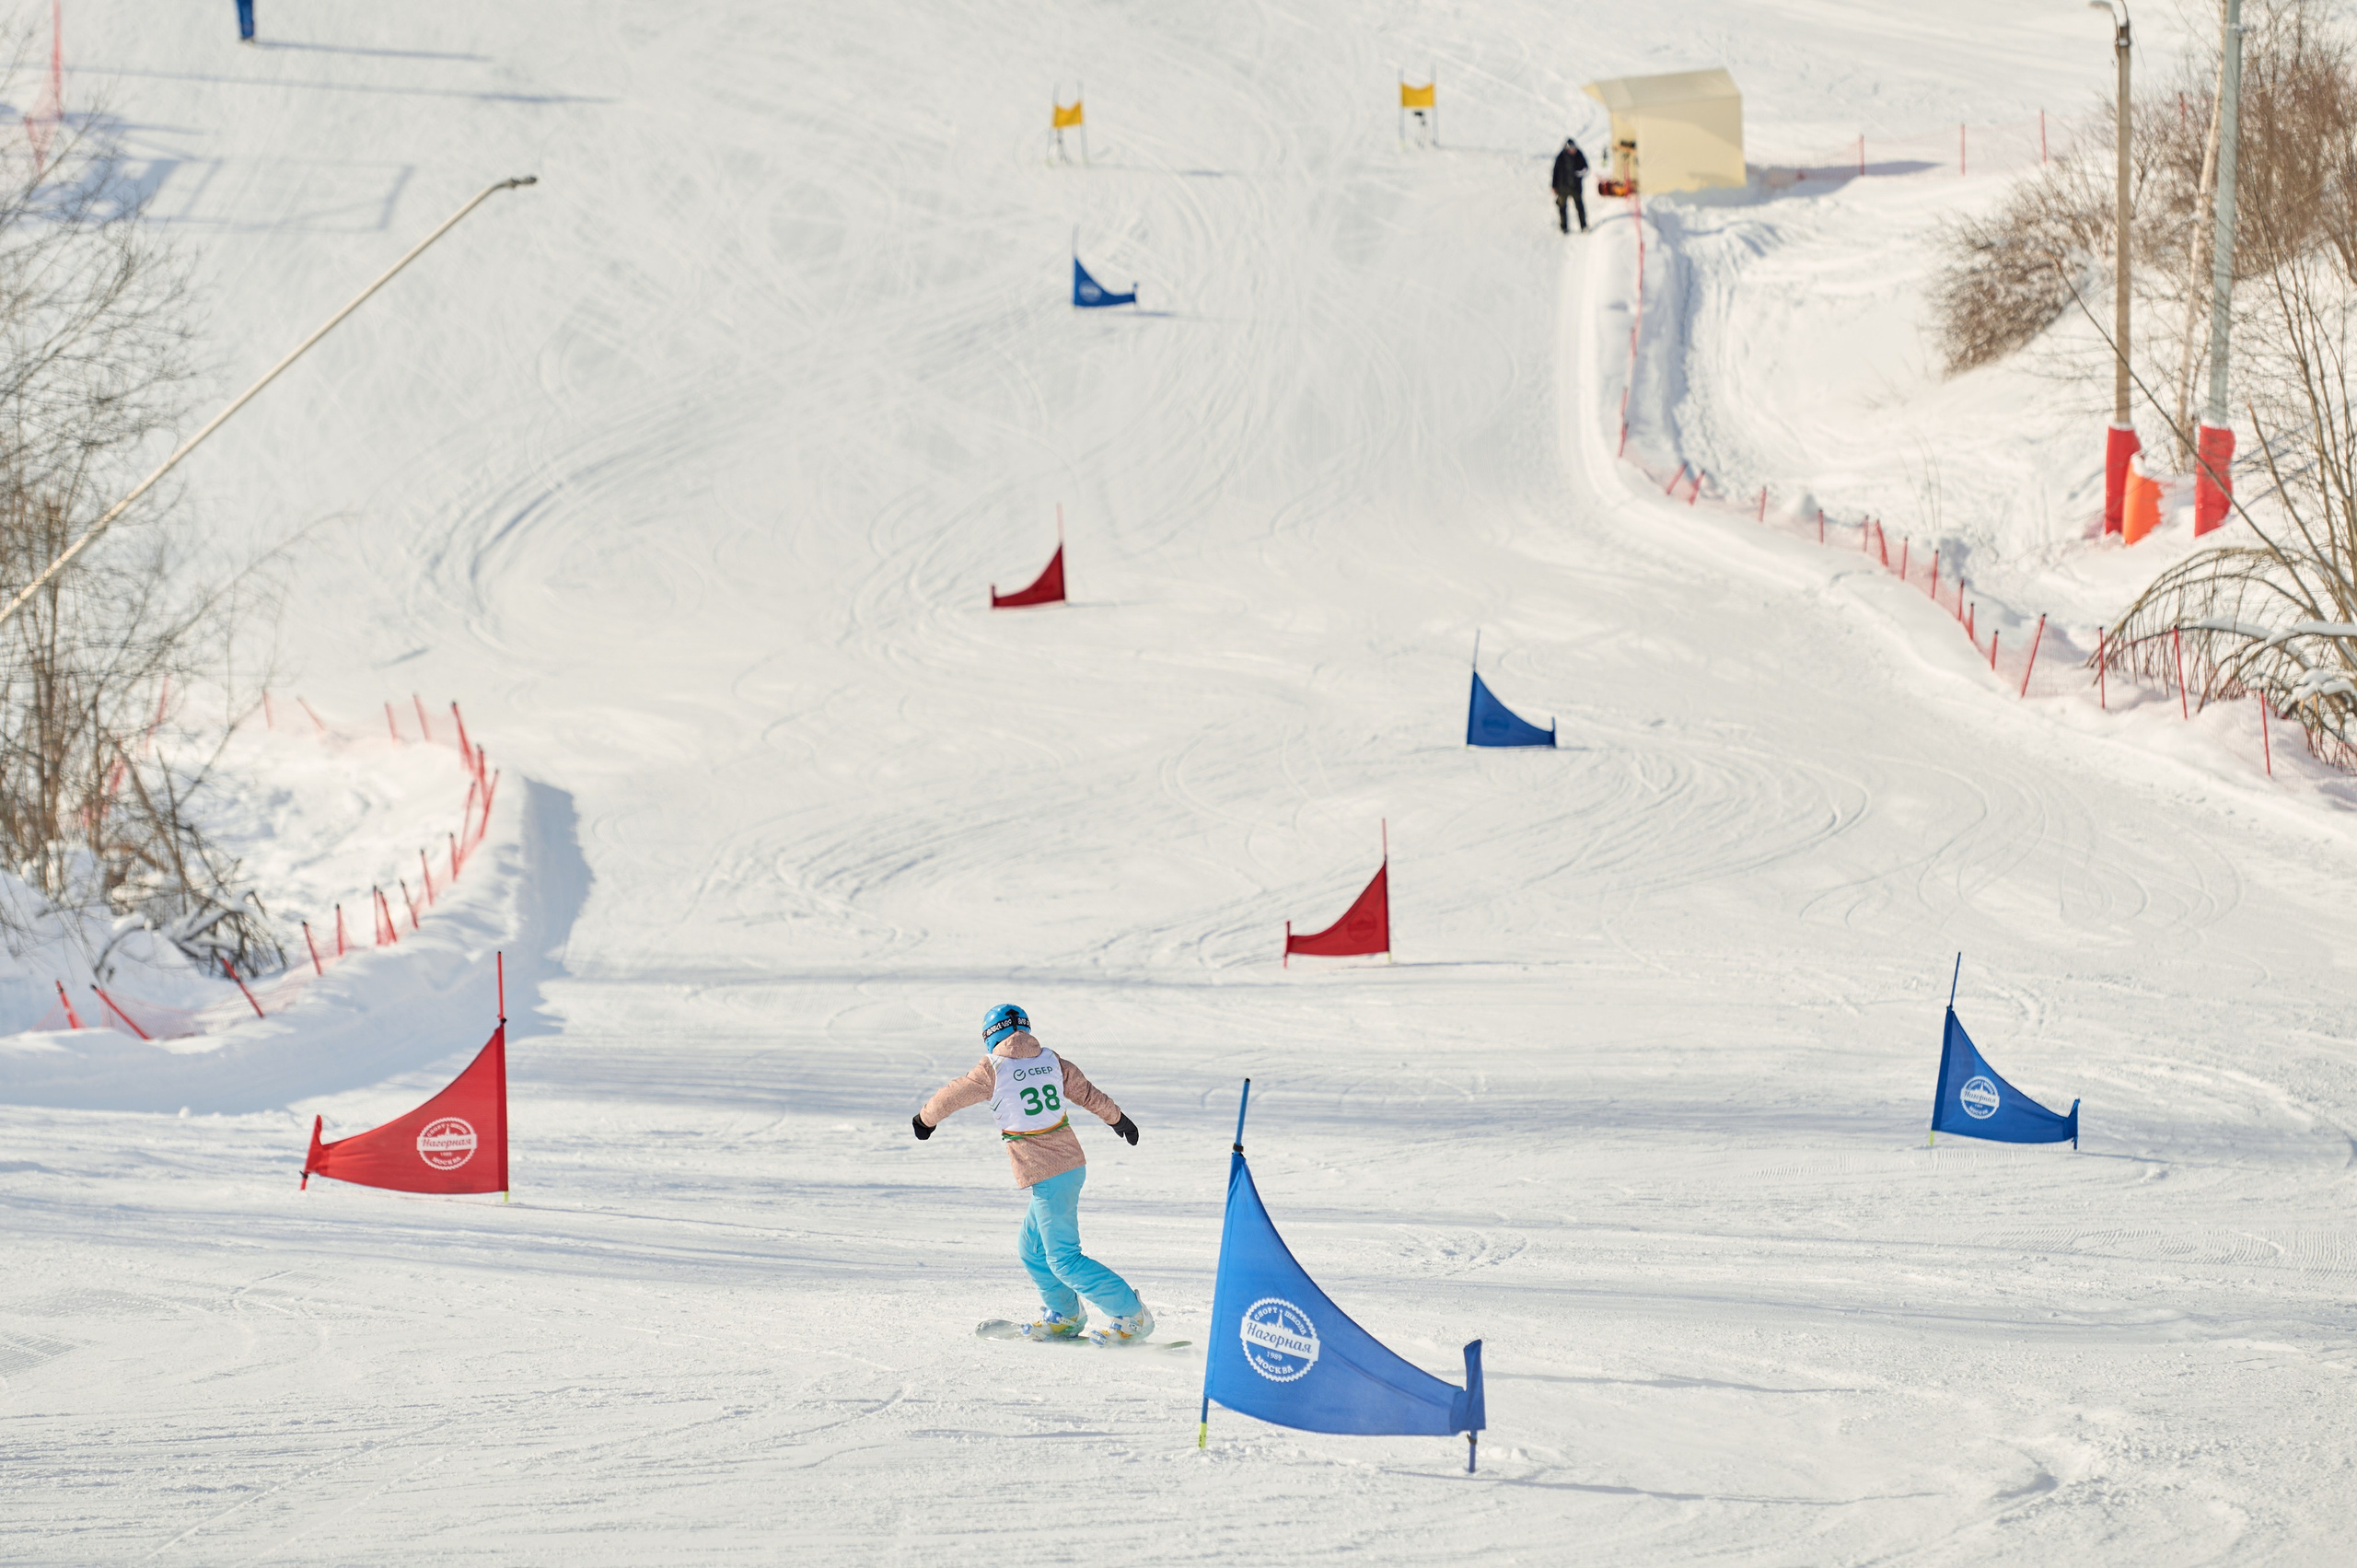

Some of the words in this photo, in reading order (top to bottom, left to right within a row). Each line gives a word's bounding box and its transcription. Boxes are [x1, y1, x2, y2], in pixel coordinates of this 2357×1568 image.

[1028, 1066, 1053, 1076] СБЕР
[1019, 1084, 1061, 1116] 38
[1254, 1307, 1278, 1321] СПОРТ
[1283, 1310, 1306, 1336] ШКОЛА
[1247, 1322, 1312, 1354] Нагорная
[1255, 1354, 1294, 1375] МОСКВА
